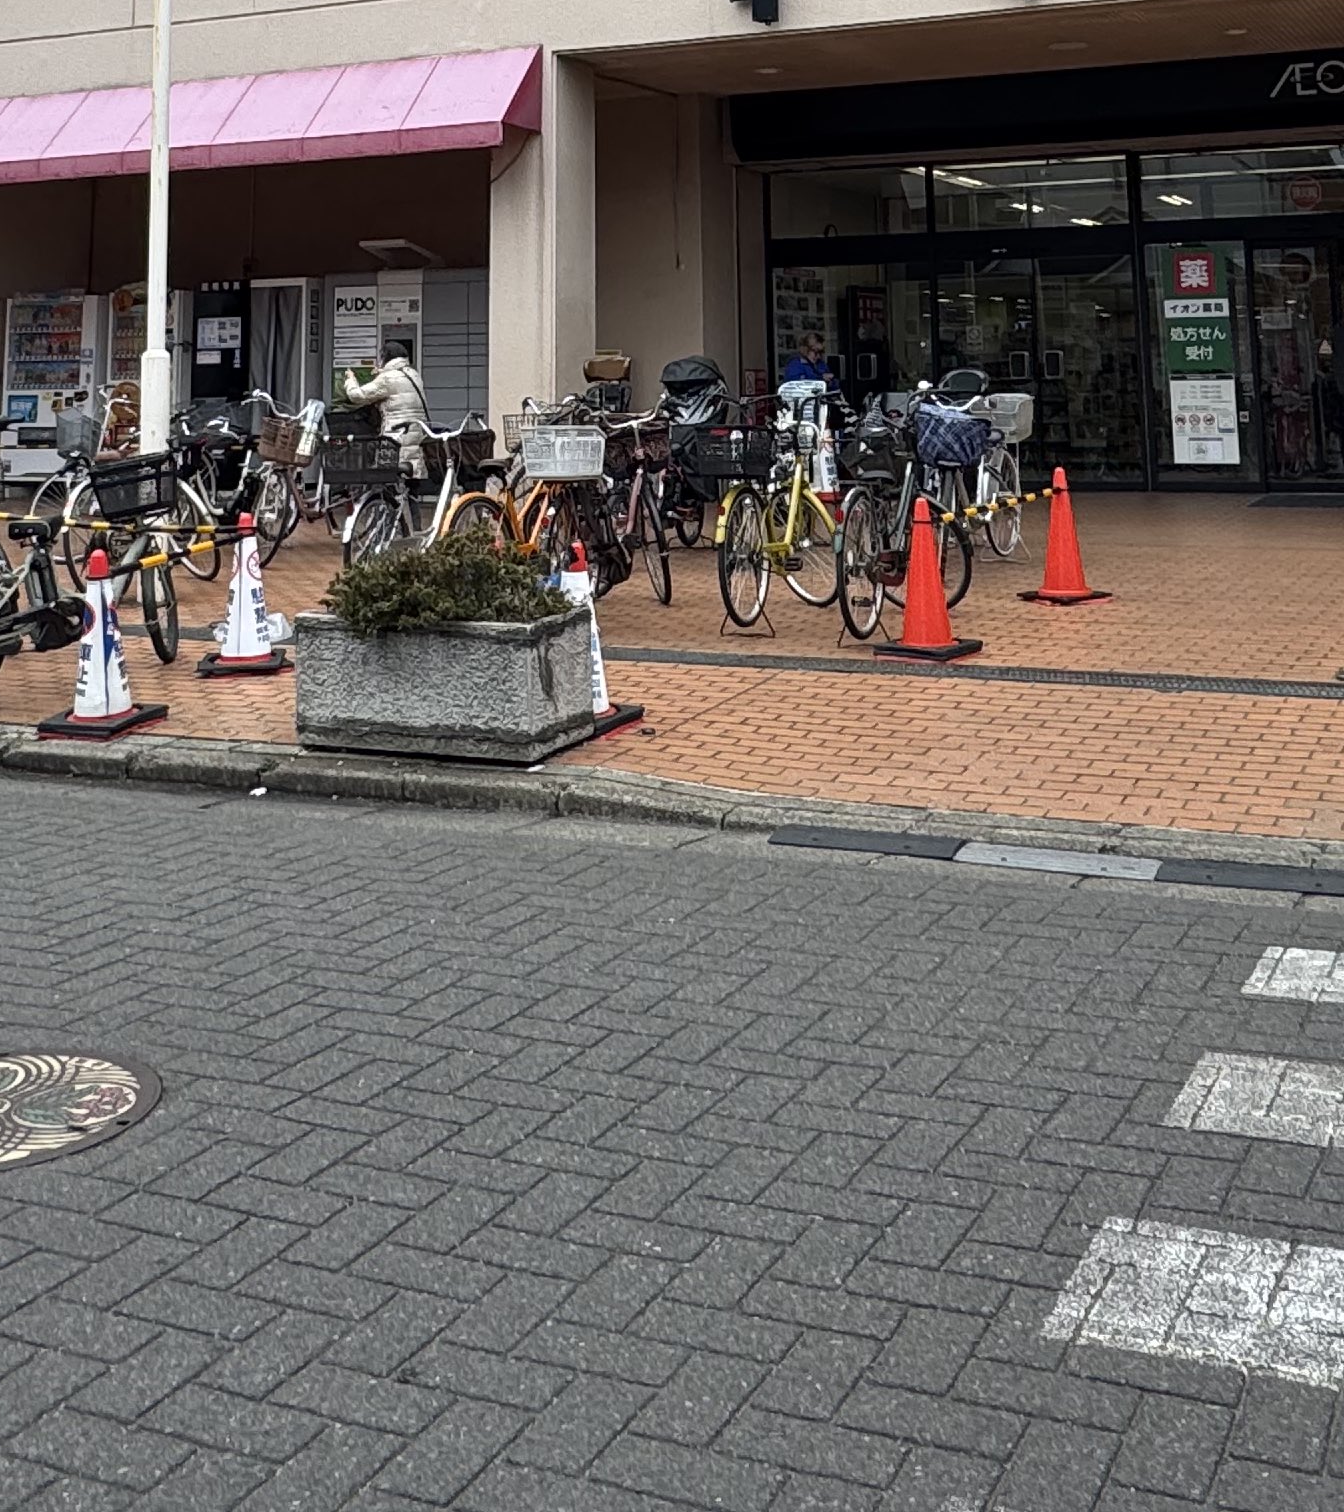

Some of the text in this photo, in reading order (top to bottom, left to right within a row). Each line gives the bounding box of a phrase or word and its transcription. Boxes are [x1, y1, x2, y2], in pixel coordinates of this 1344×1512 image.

[1178, 259, 1210, 289] 薬
[336, 297, 376, 312] PUDO
[1169, 302, 1224, 315] イオン薬局
[1170, 326, 1227, 342] 処方せん
[1185, 345, 1214, 361] 受付
